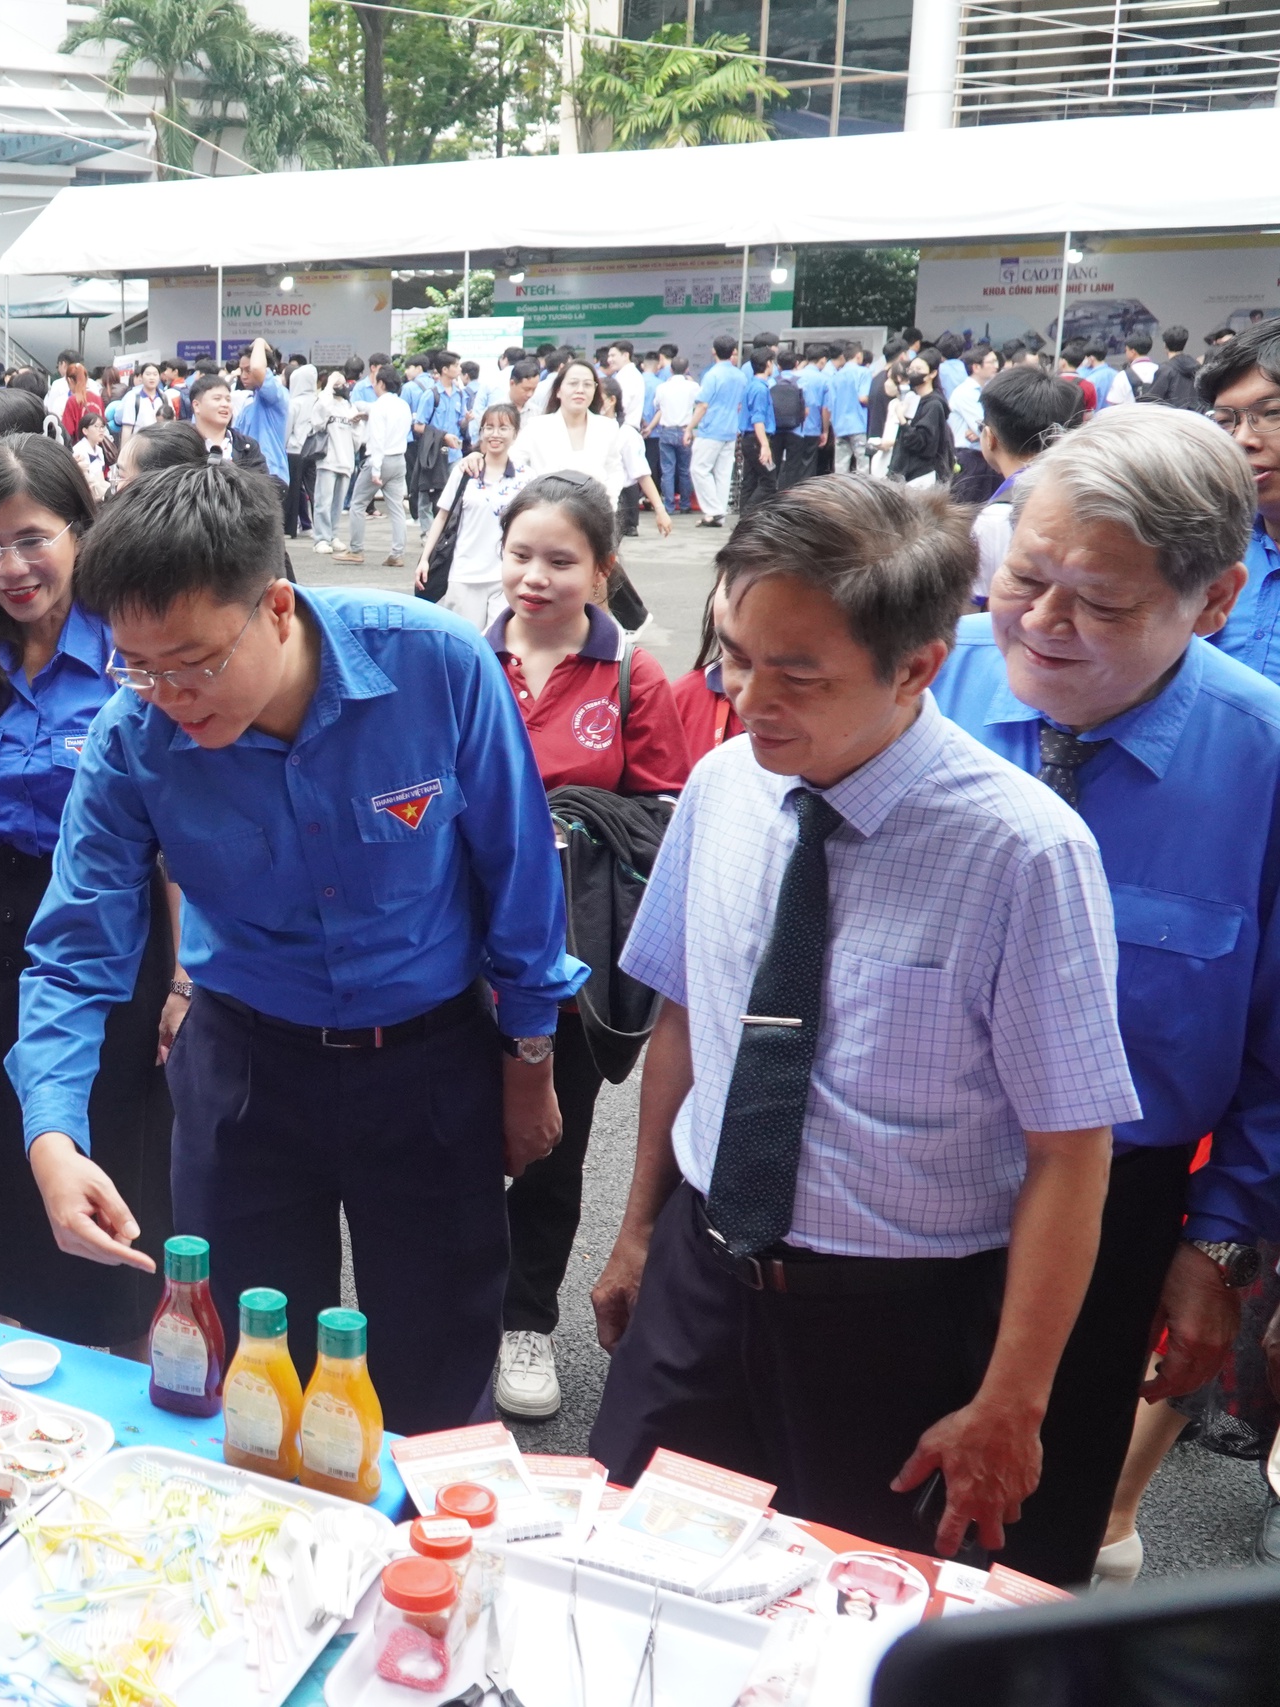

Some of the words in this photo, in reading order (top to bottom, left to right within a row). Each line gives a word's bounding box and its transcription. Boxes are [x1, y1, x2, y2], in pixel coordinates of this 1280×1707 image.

[1022, 267, 1049, 281] CAO
[982, 286, 1006, 296] KHOA
[1008, 284, 1032, 296] CÔNG
[1035, 283, 1059, 295] NGHỆ
[1090, 282, 1114, 293] LẠNH
[244, 301, 262, 317] VŨ
[265, 303, 311, 316] FABRIC
